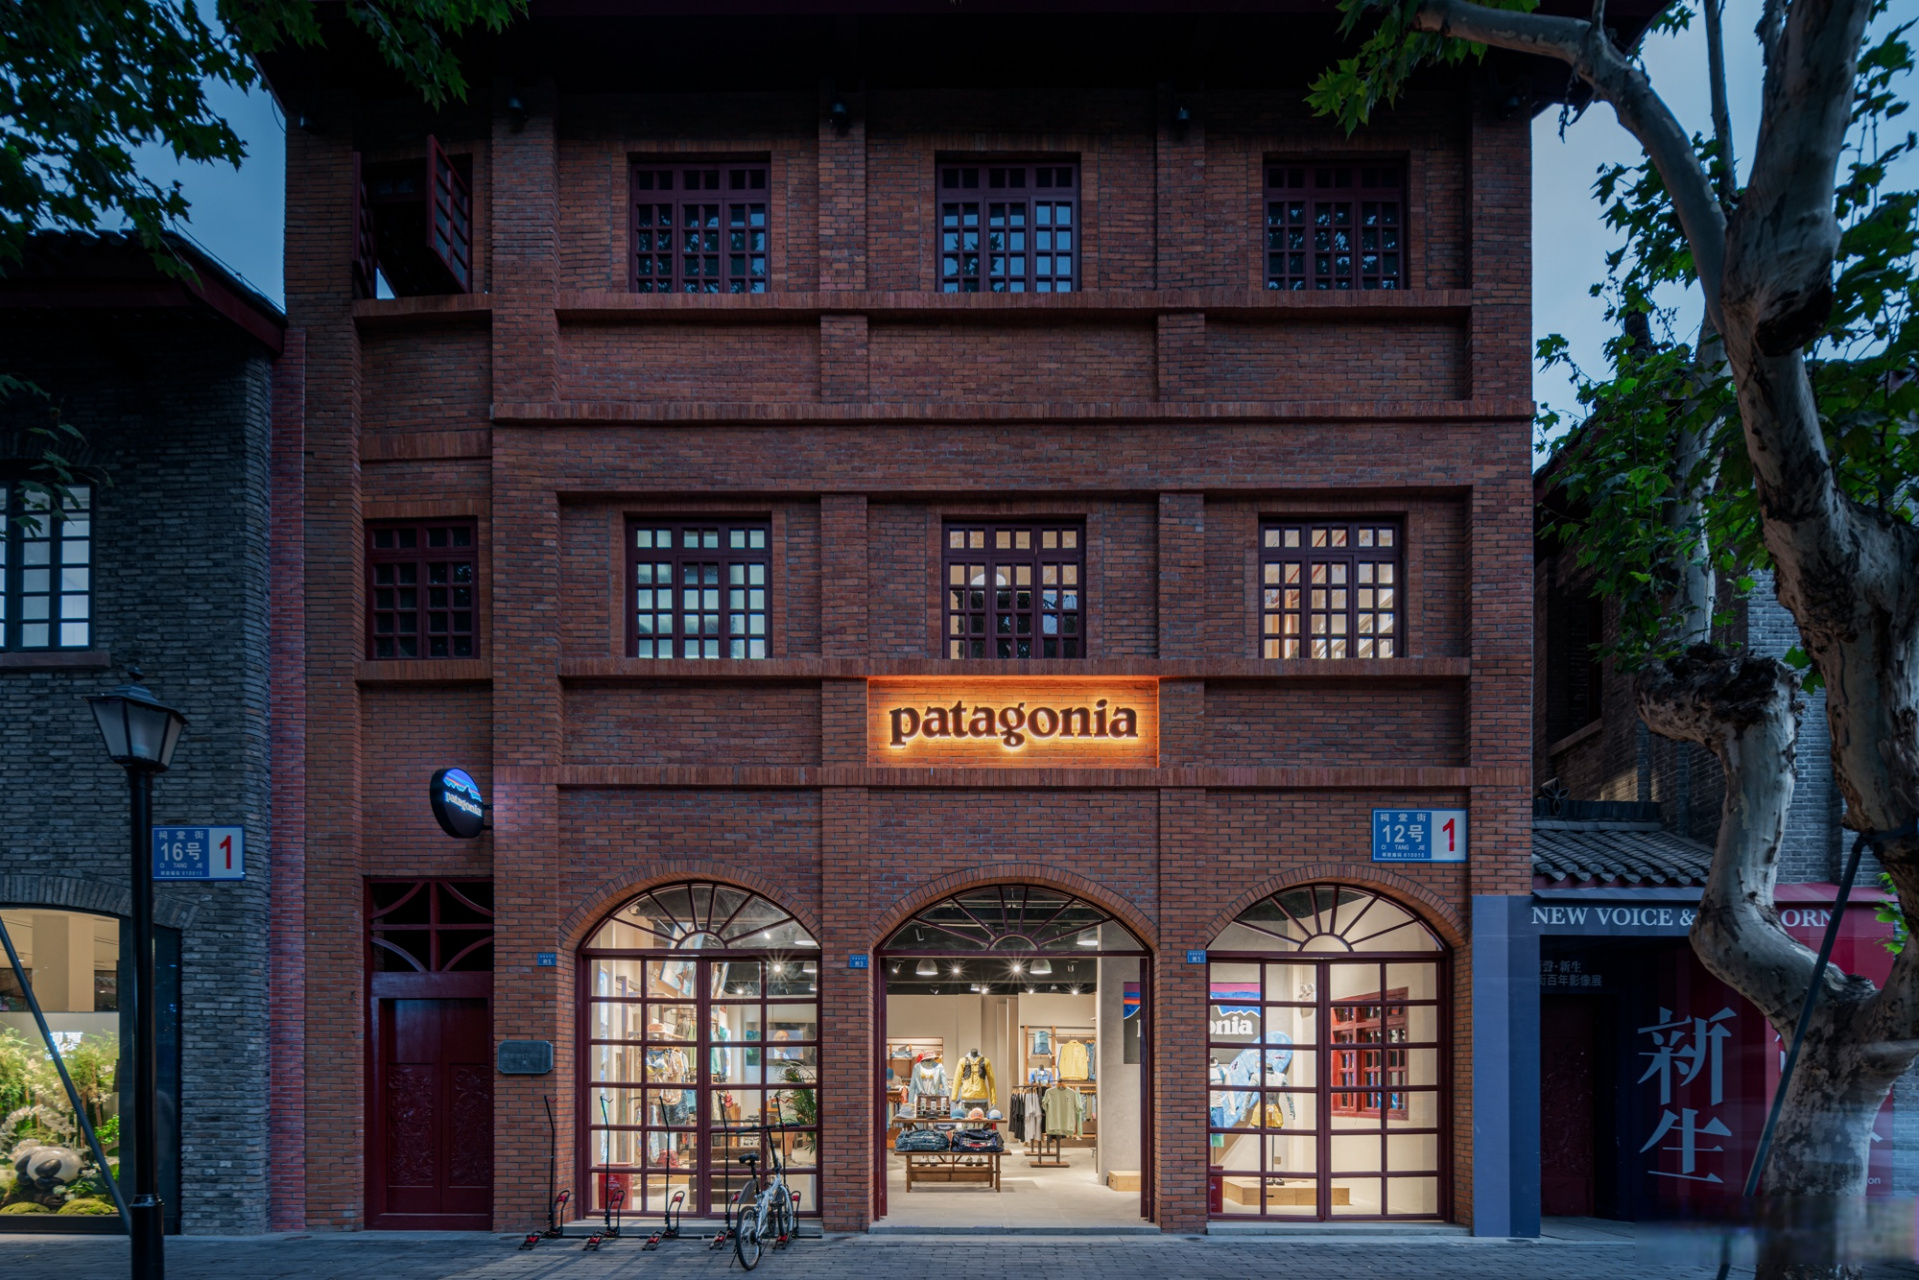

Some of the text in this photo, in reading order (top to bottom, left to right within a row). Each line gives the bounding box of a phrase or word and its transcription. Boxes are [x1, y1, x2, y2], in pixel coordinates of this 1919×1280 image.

[889, 699, 1138, 748] patagonia
[445, 791, 483, 817] patagonia
[1380, 813, 1426, 822] 祠堂街
[158, 830, 204, 840] 祠堂街
[1382, 824, 1424, 843] 12号
[1442, 817, 1455, 852] 1
[160, 842, 202, 861] 16号
[219, 835, 232, 869] 1
[1531, 906, 1833, 927] NEW VOICE & ORN
[1540, 960, 1582, 973] 聲·新生
[1636, 1006, 1737, 1185] 新生
